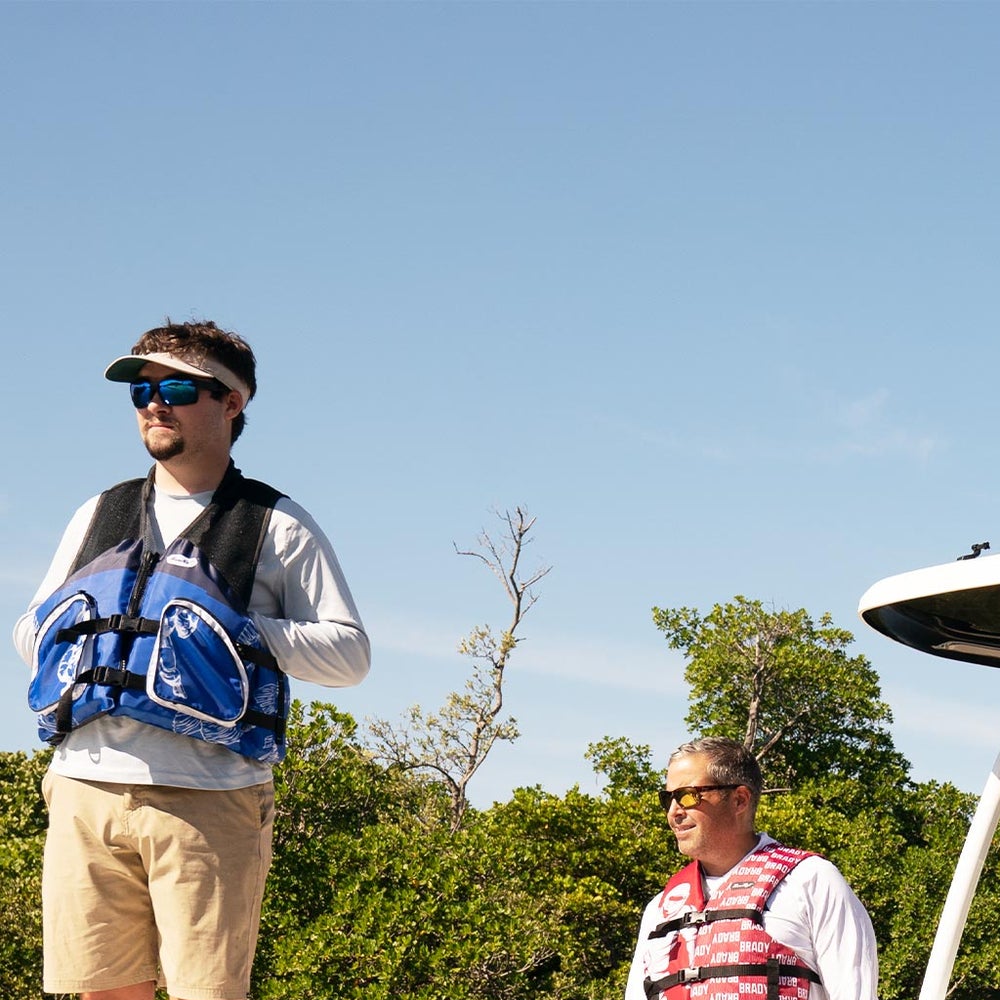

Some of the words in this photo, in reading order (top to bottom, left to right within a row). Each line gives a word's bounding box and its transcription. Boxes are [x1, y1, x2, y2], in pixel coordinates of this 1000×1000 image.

[770, 853, 802, 863] BRADY
[720, 895, 750, 907] BRADY
[712, 931, 740, 944] BRADY
[740, 941, 770, 953] BRADY
[711, 951, 740, 963] BRADY
[739, 982, 768, 995] BRADY
